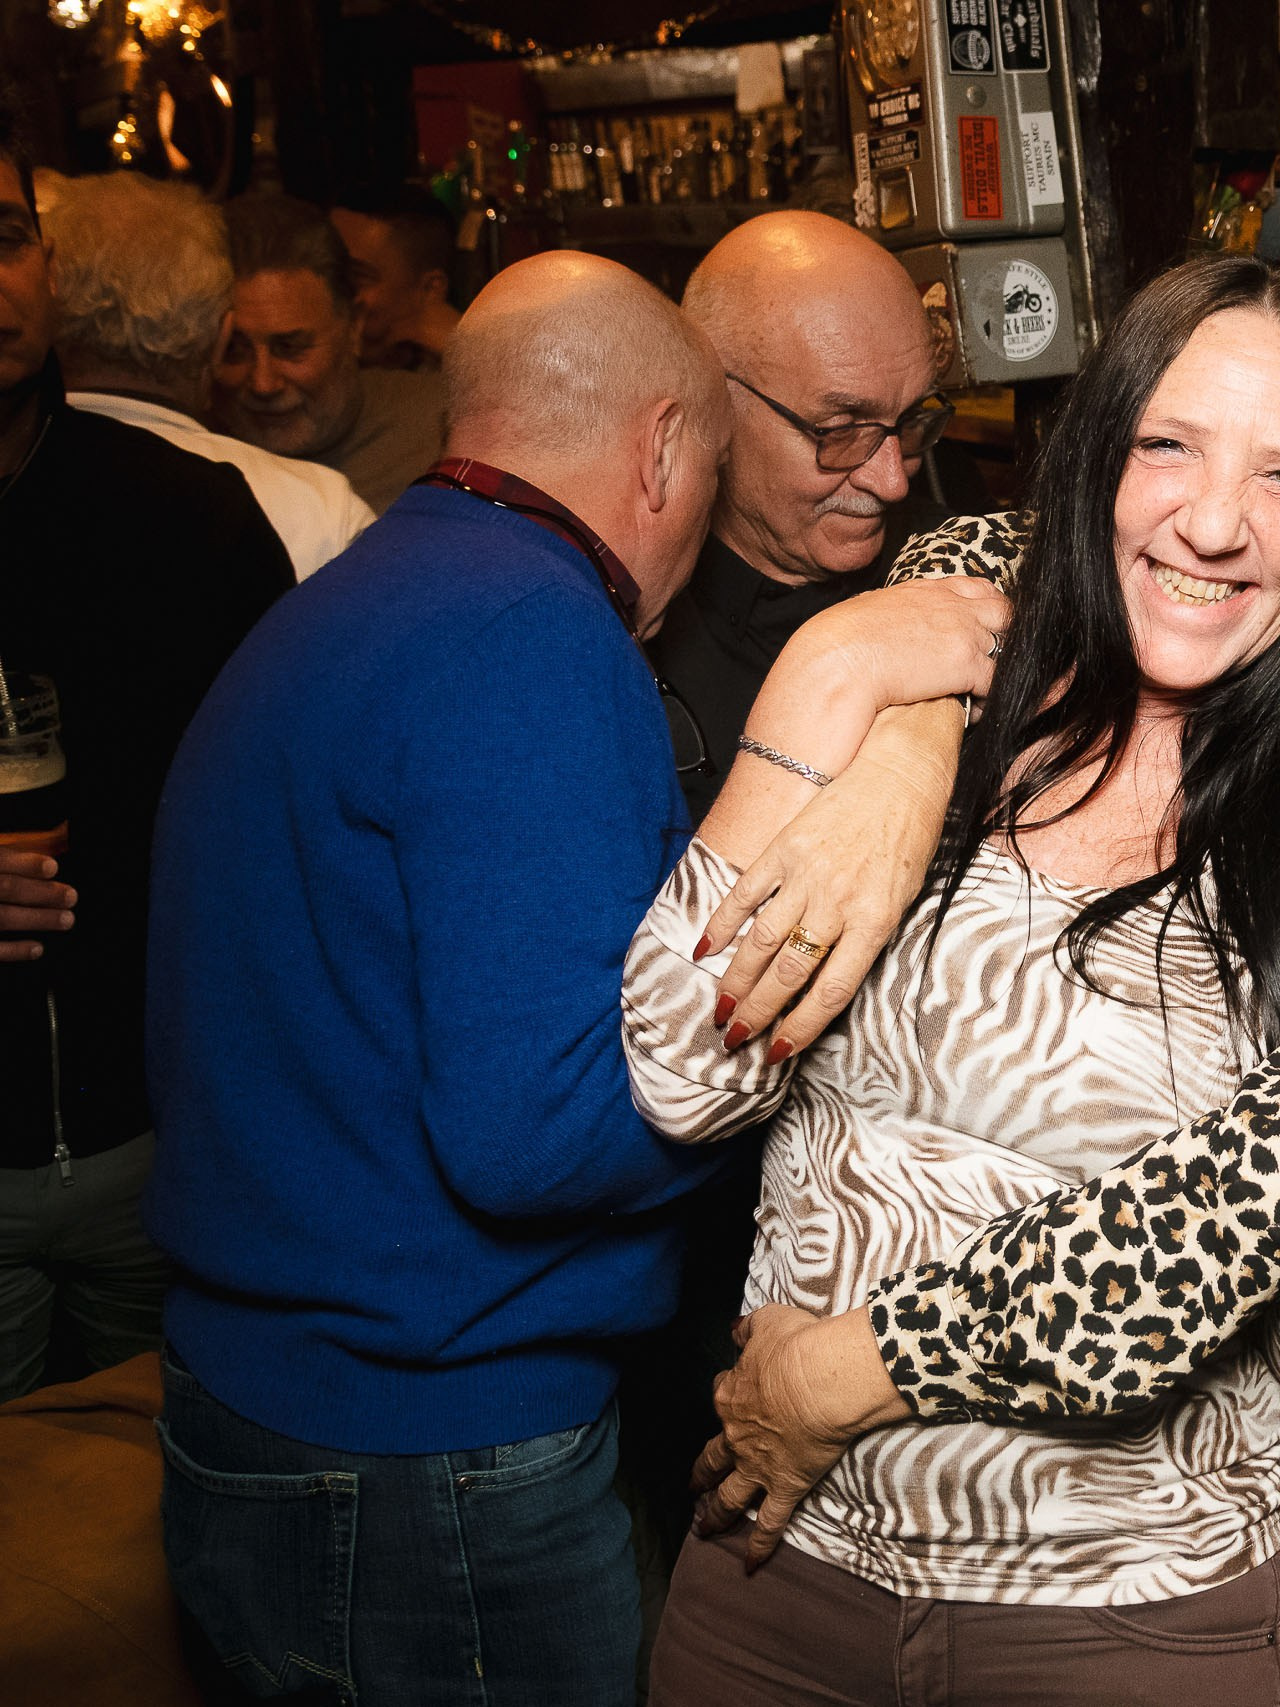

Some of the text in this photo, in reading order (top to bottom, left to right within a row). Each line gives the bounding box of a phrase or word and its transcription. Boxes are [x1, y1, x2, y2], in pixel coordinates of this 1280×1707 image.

[951, 0, 960, 24] SUPP
[1027, 0, 1042, 58] ardinals
[973, 121, 989, 213] DEVIL DOLLS
[1022, 133, 1036, 188] SUPPORT
[1031, 121, 1047, 194] TAURUS MC
[1043, 140, 1055, 176] SPAIN
[1003, 319, 1013, 335] K
